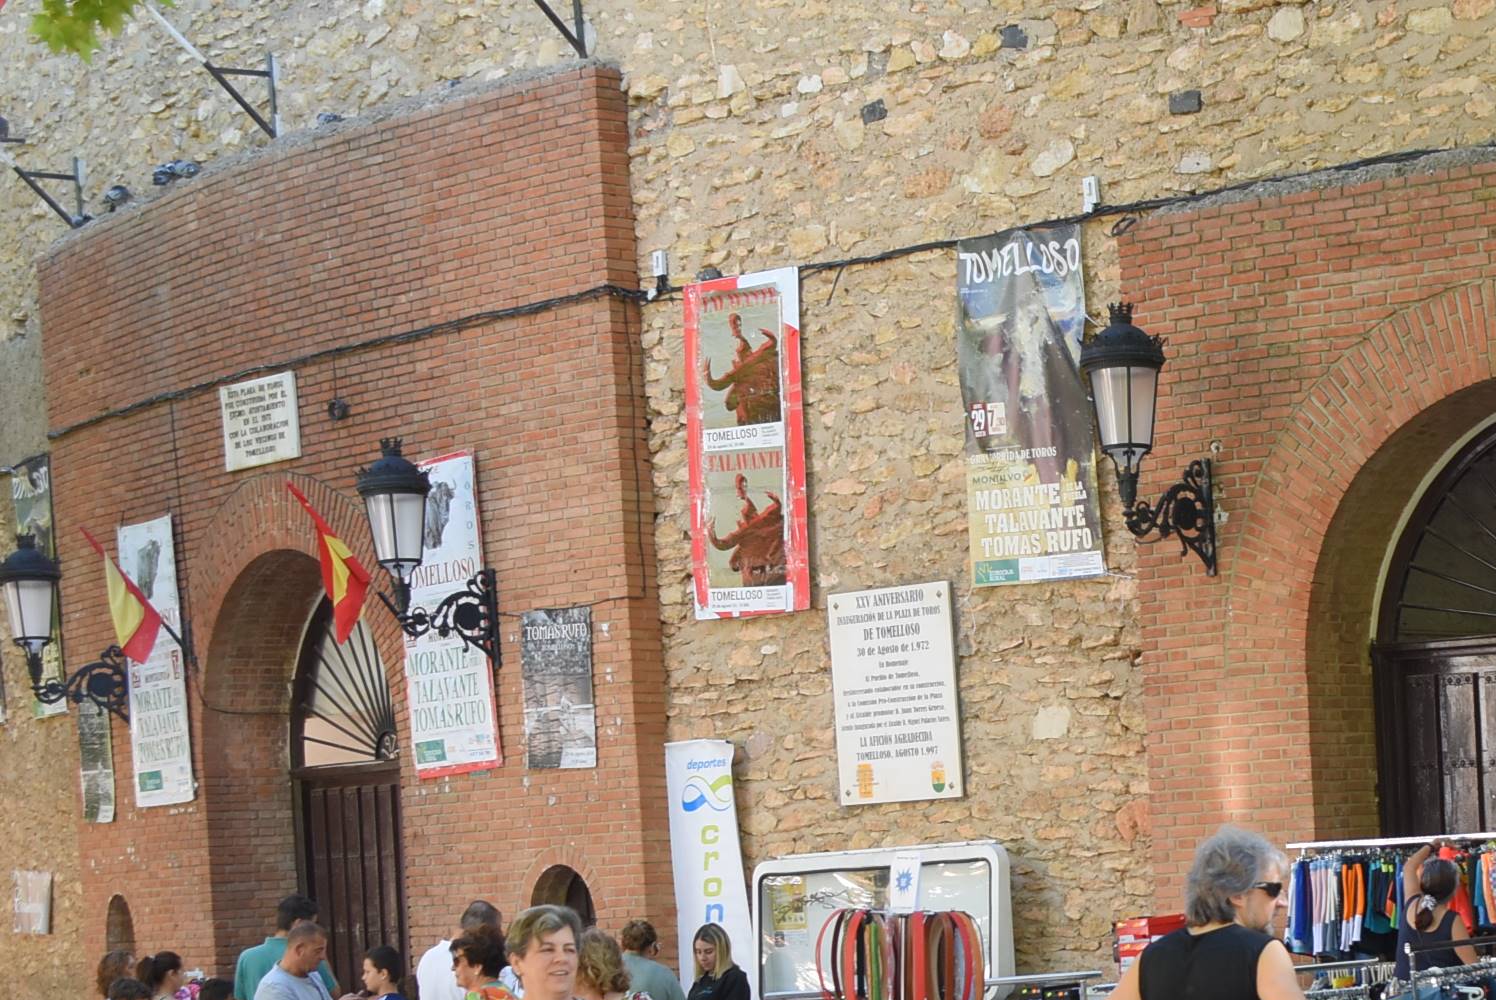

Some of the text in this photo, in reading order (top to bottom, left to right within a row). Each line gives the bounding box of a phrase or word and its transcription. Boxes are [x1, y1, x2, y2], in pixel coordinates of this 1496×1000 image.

[959, 238, 1080, 286] TOMELLOSO
[971, 409, 985, 431] 29
[707, 428, 758, 442] TOMELLOSO
[707, 449, 783, 473] TALAVANTE
[1032, 446, 1057, 458] TOROS
[975, 482, 1060, 511] MORANTE
[985, 504, 1087, 534] TALAVANTE
[981, 527, 1093, 558] TOMAS RUFO
[411, 556, 476, 591] OMELLOSO
[711, 590, 763, 601] TOMELLOSO
[856, 589, 924, 609] XXV ANIVERSARIO
[894, 608, 911, 619] PLAZA
[913, 607, 920, 616] DE
[922, 605, 941, 615] TOROS
[525, 624, 561, 641] TOMAS
[863, 622, 920, 641] DE TOMELLOSO
[867, 646, 875, 656] de
[877, 643, 899, 656] Agosto
[901, 642, 909, 652] de
[409, 646, 469, 677] MORANTE
[415, 672, 479, 705] TALAVANTE
[415, 699, 486, 733] TOMAS RUFO
[860, 736, 868, 747] LA
[894, 730, 933, 744] AGRADECIDA
[895, 747, 919, 758] AGOSTO
[686, 757, 727, 772] deportes
